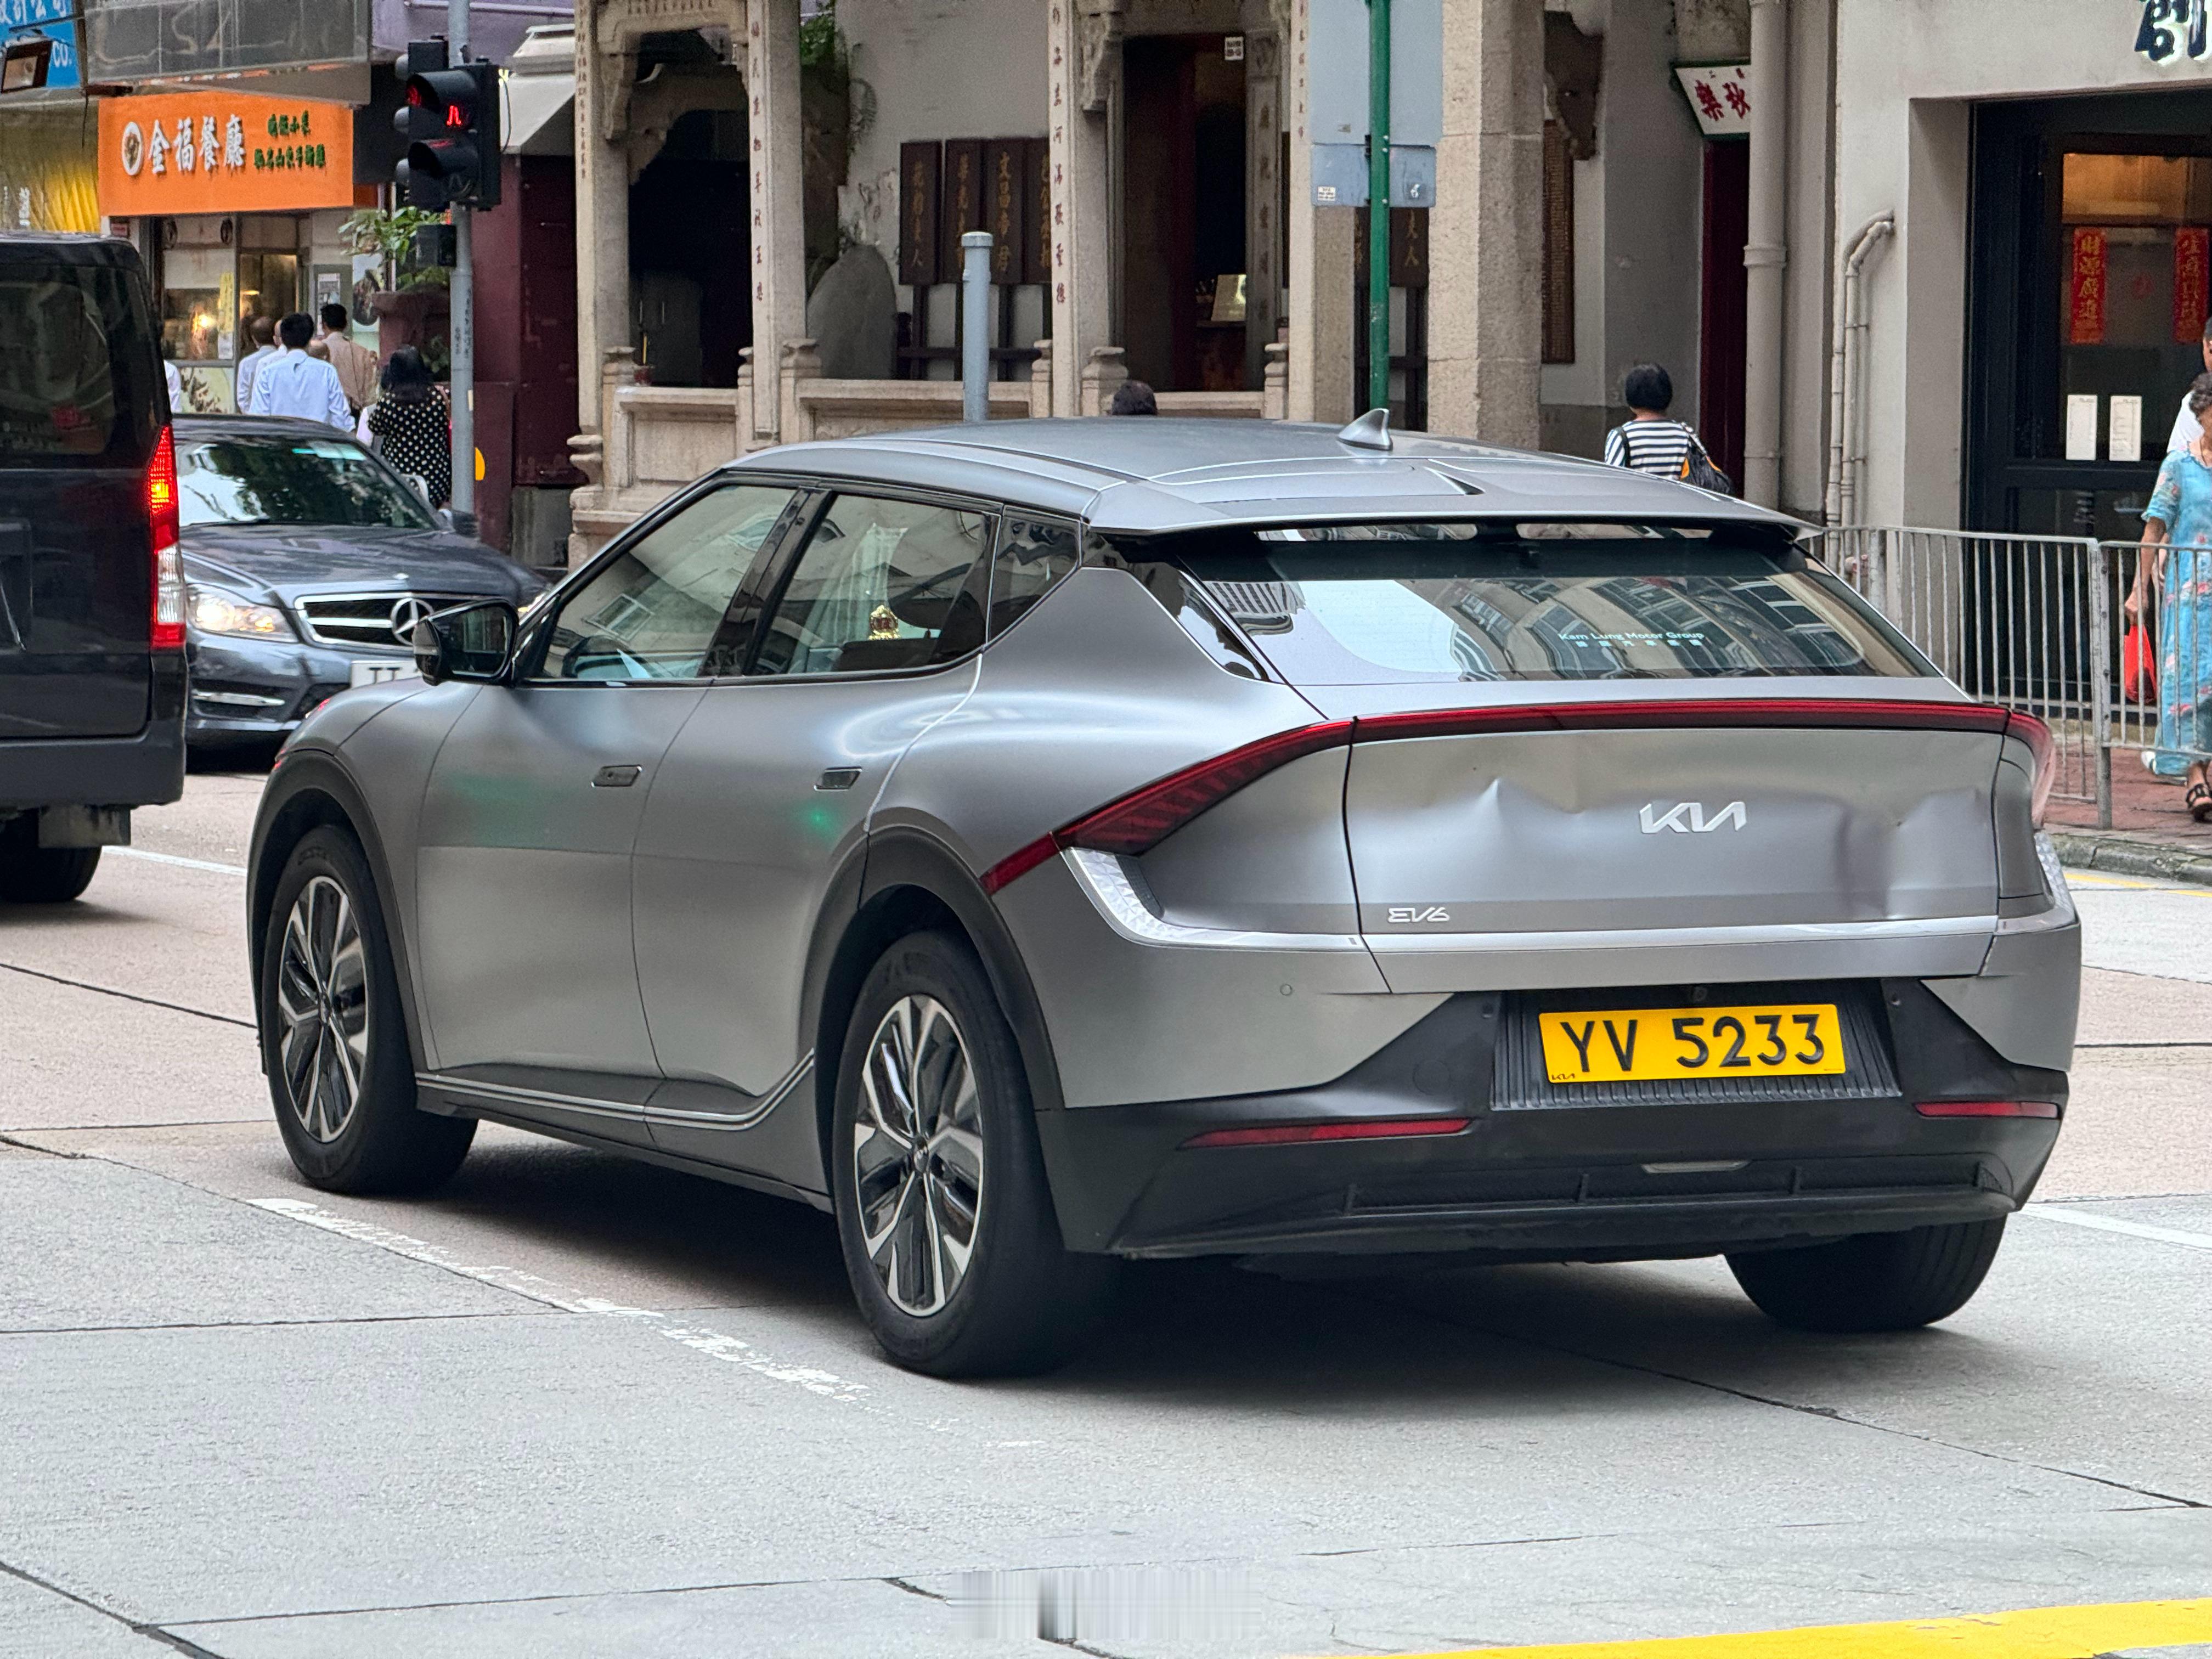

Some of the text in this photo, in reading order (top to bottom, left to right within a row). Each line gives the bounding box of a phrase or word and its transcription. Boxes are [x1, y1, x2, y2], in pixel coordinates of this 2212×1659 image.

[148, 114, 245, 174] 金福餐廳
[1558, 633, 1589, 641] Kam
[1639, 801, 1747, 833] KIA
[1388, 906, 1451, 923] EV6
[1559, 1013, 1825, 1073] YV 5233
